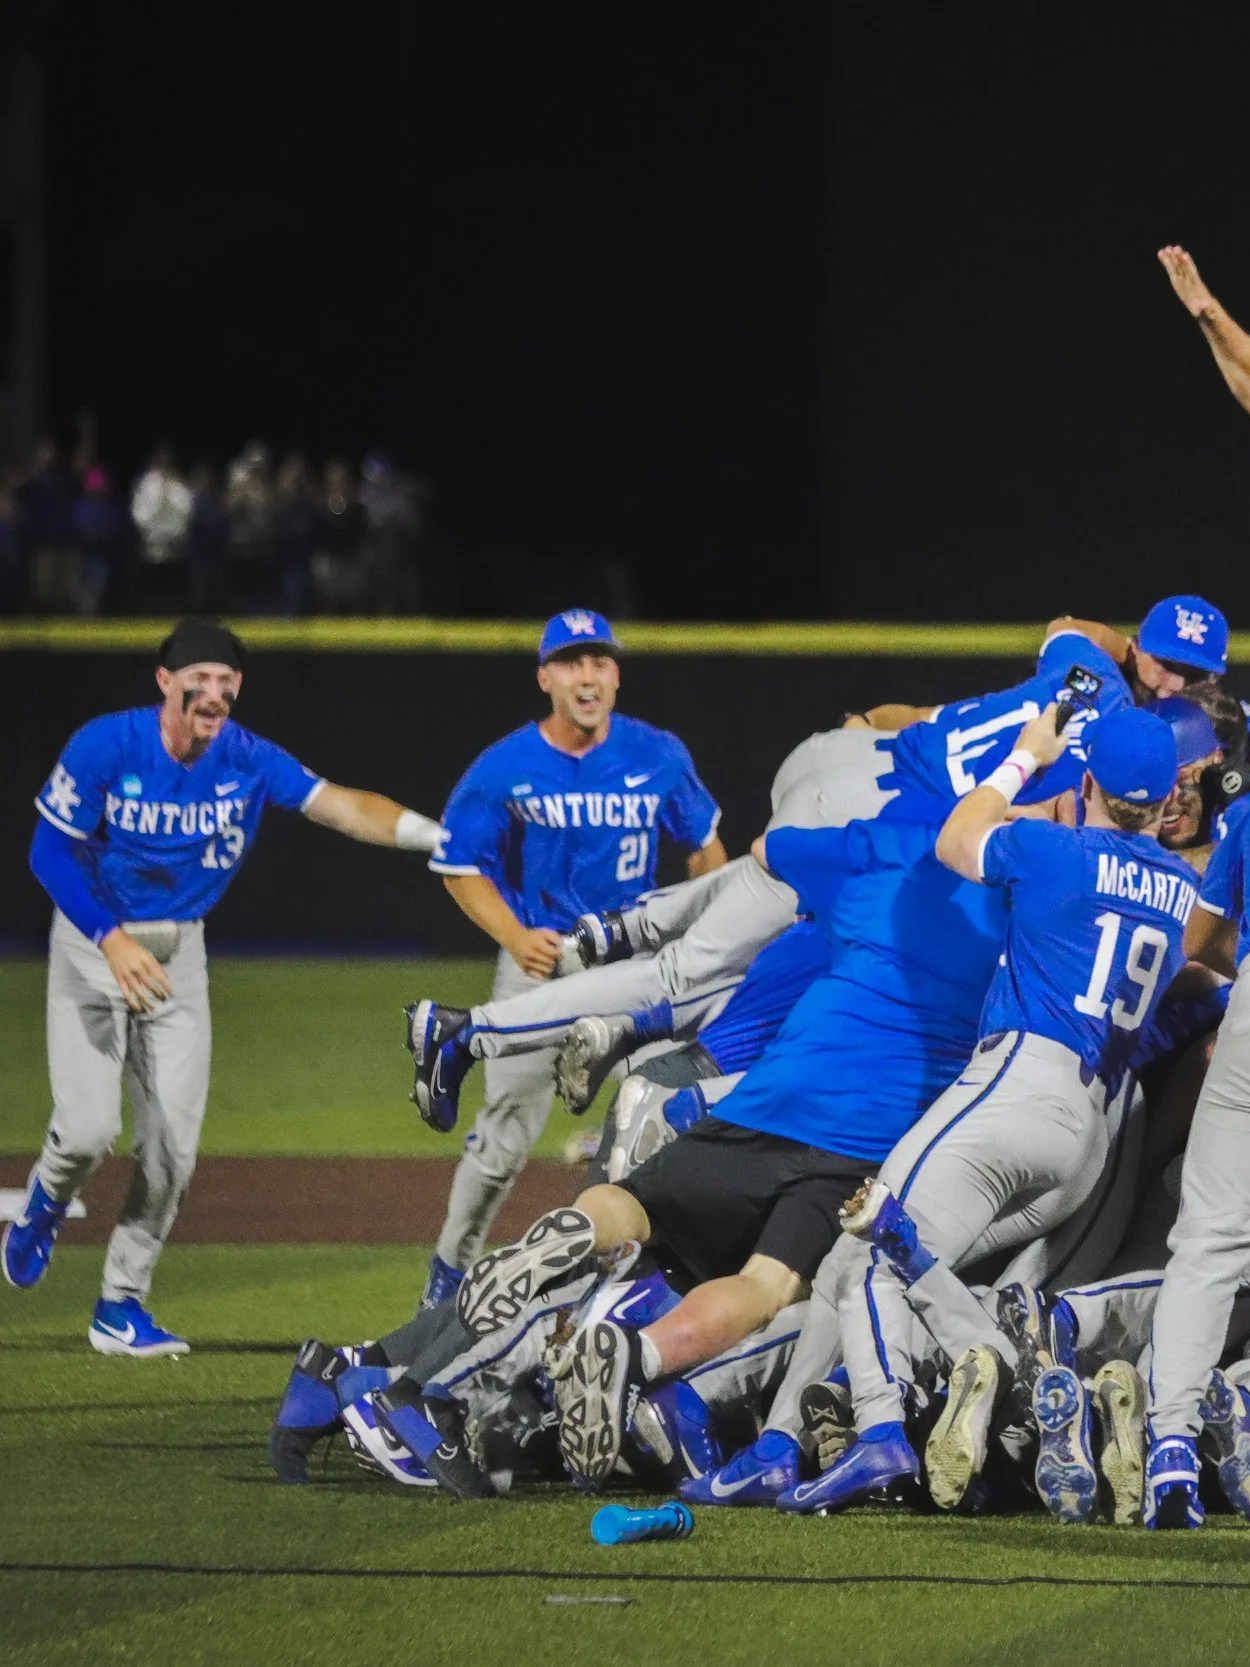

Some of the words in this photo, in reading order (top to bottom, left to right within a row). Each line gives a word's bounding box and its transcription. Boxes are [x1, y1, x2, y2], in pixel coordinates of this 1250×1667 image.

[201, 824, 245, 871] 13
[615, 830, 649, 882] 21
[1073, 911, 1169, 1032] 19
